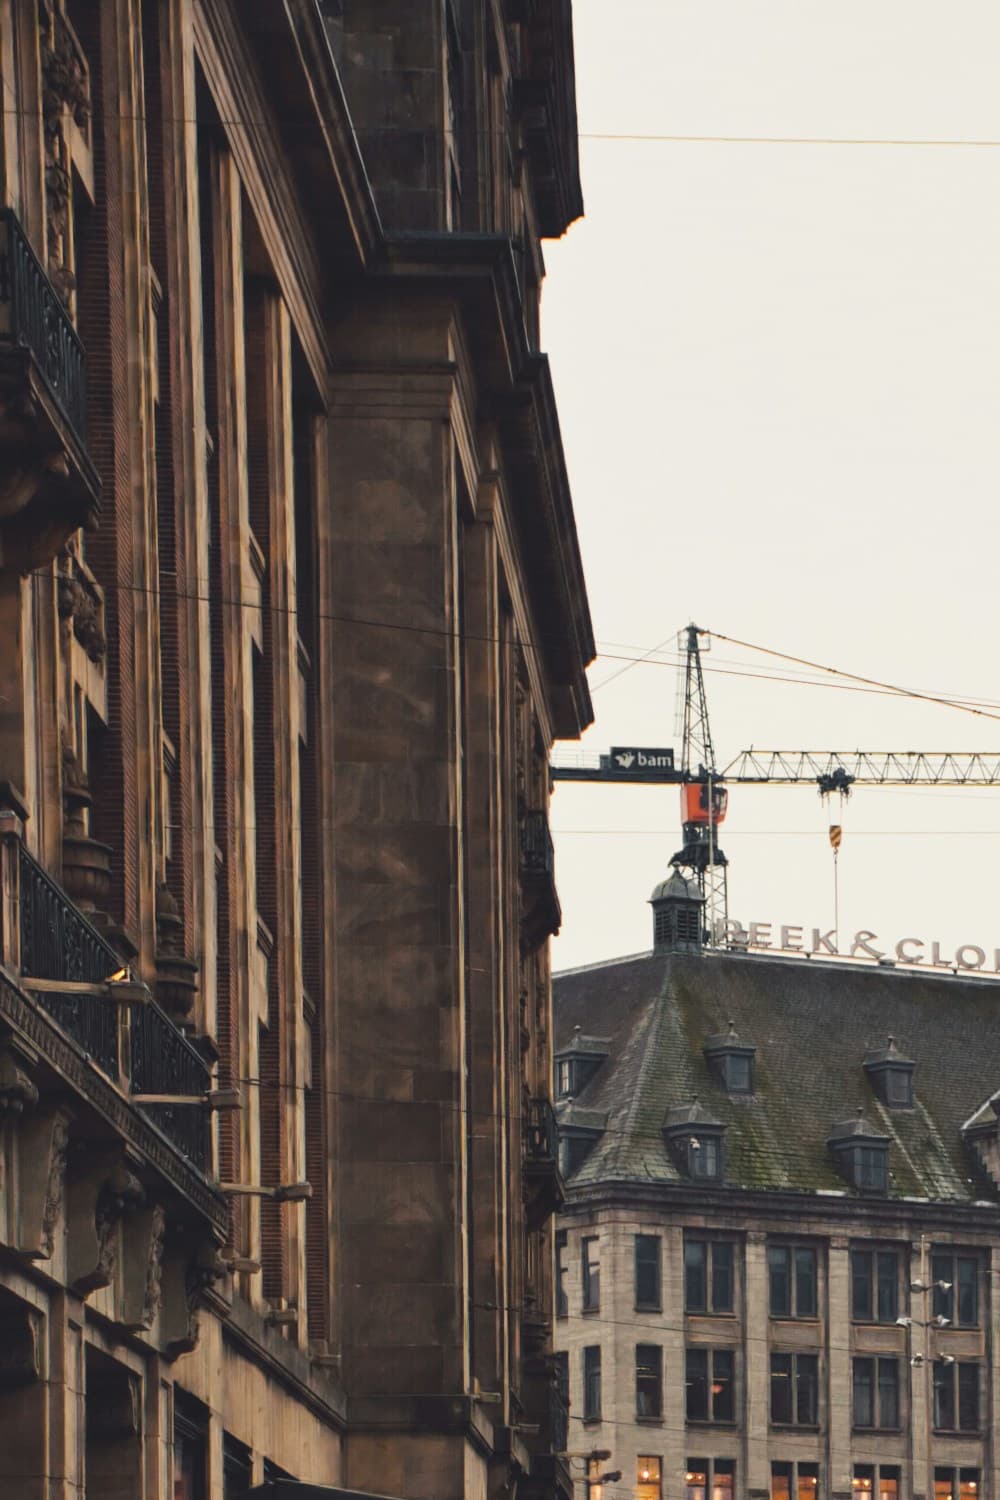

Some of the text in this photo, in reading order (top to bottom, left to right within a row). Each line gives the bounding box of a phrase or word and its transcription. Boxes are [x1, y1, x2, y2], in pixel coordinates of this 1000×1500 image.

[637, 752, 672, 768] bam
[716, 917, 839, 955] PEEK
[850, 930, 886, 959] &
